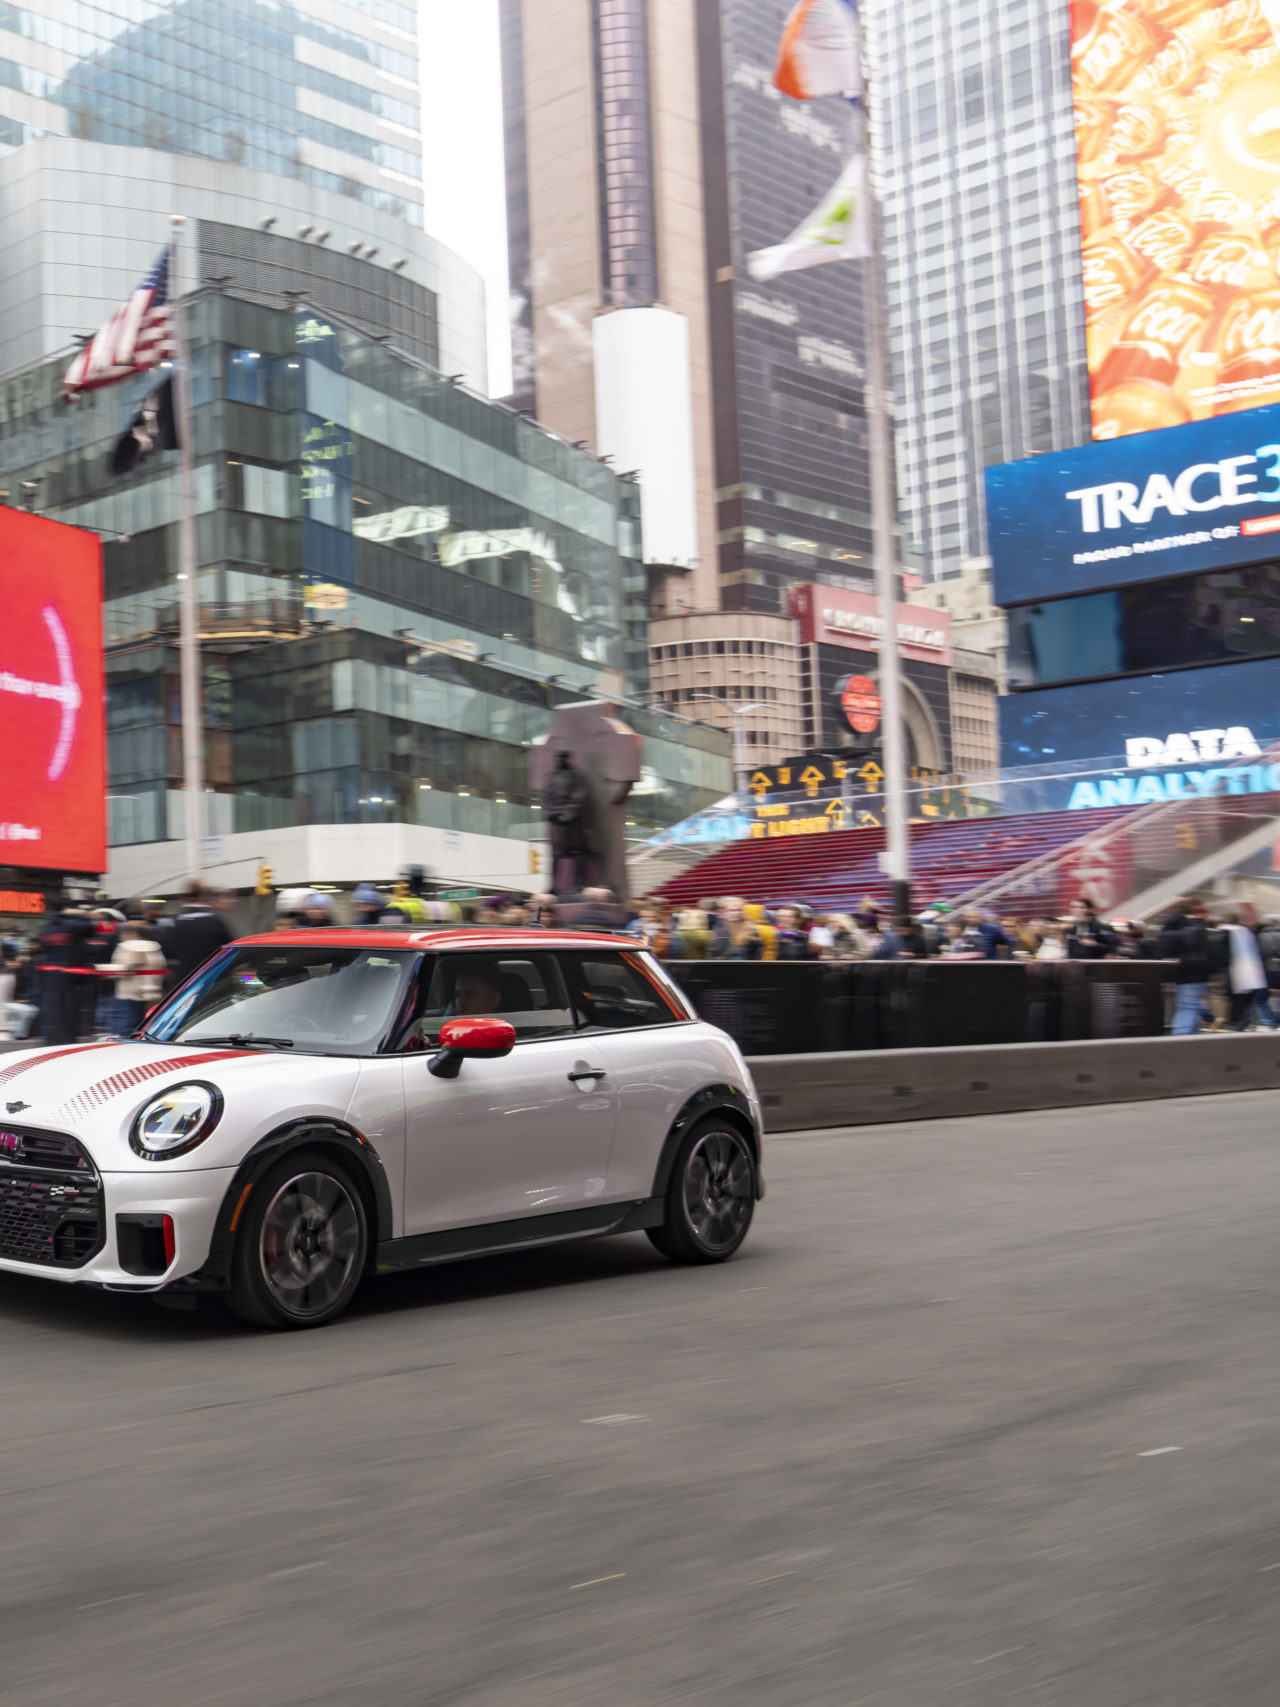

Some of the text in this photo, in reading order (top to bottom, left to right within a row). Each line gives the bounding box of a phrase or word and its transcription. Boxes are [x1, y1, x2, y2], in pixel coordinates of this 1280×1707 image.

[1066, 444, 1280, 532] TRACE3
[1073, 546, 1132, 564] PROUD
[1126, 726, 1263, 767] DATA
